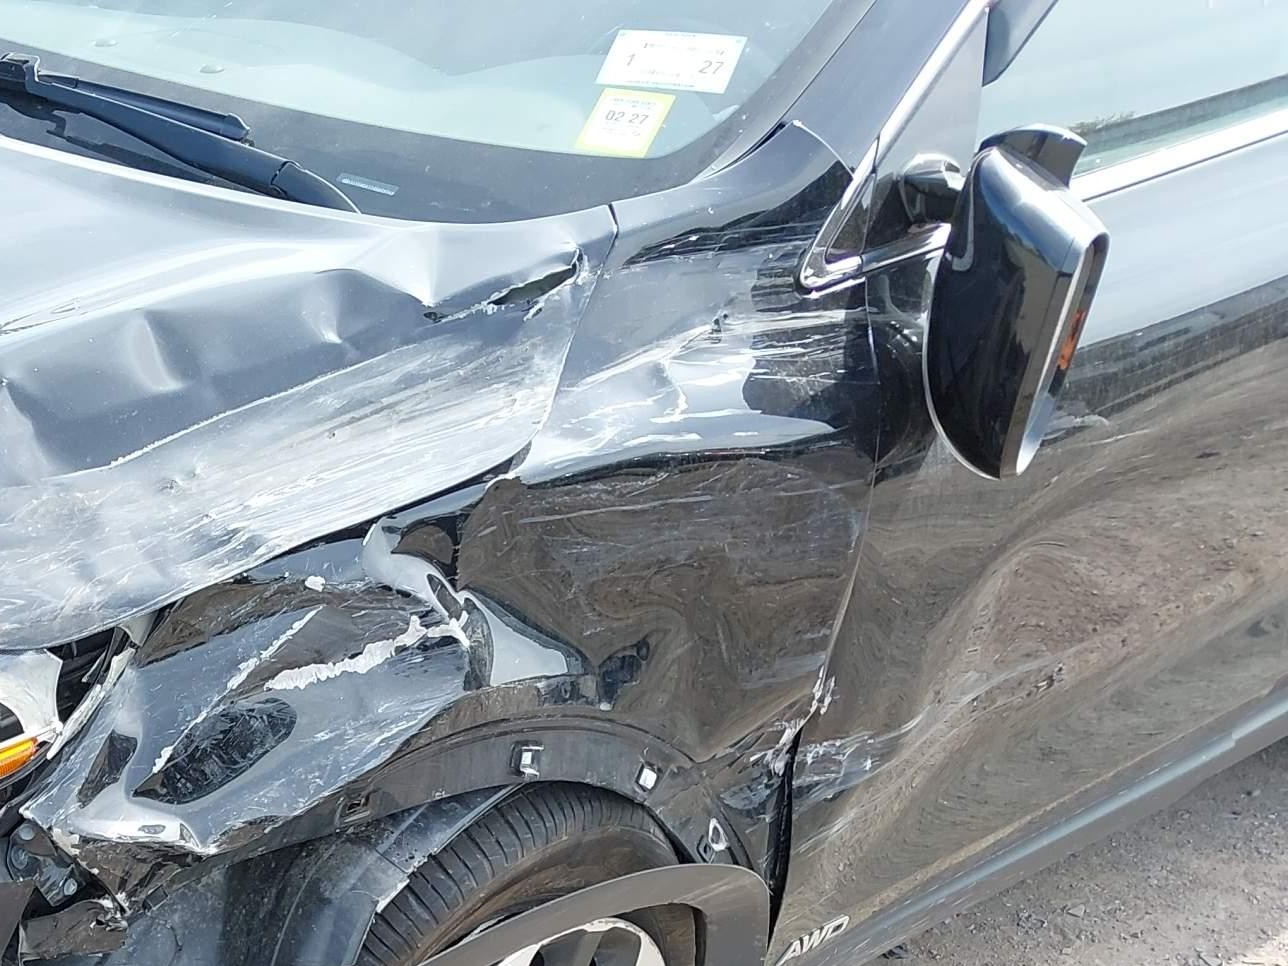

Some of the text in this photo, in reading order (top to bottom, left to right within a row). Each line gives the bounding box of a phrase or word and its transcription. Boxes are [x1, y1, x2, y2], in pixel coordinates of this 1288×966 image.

[698, 60, 724, 75] 27
[605, 110, 649, 125] 02 27
